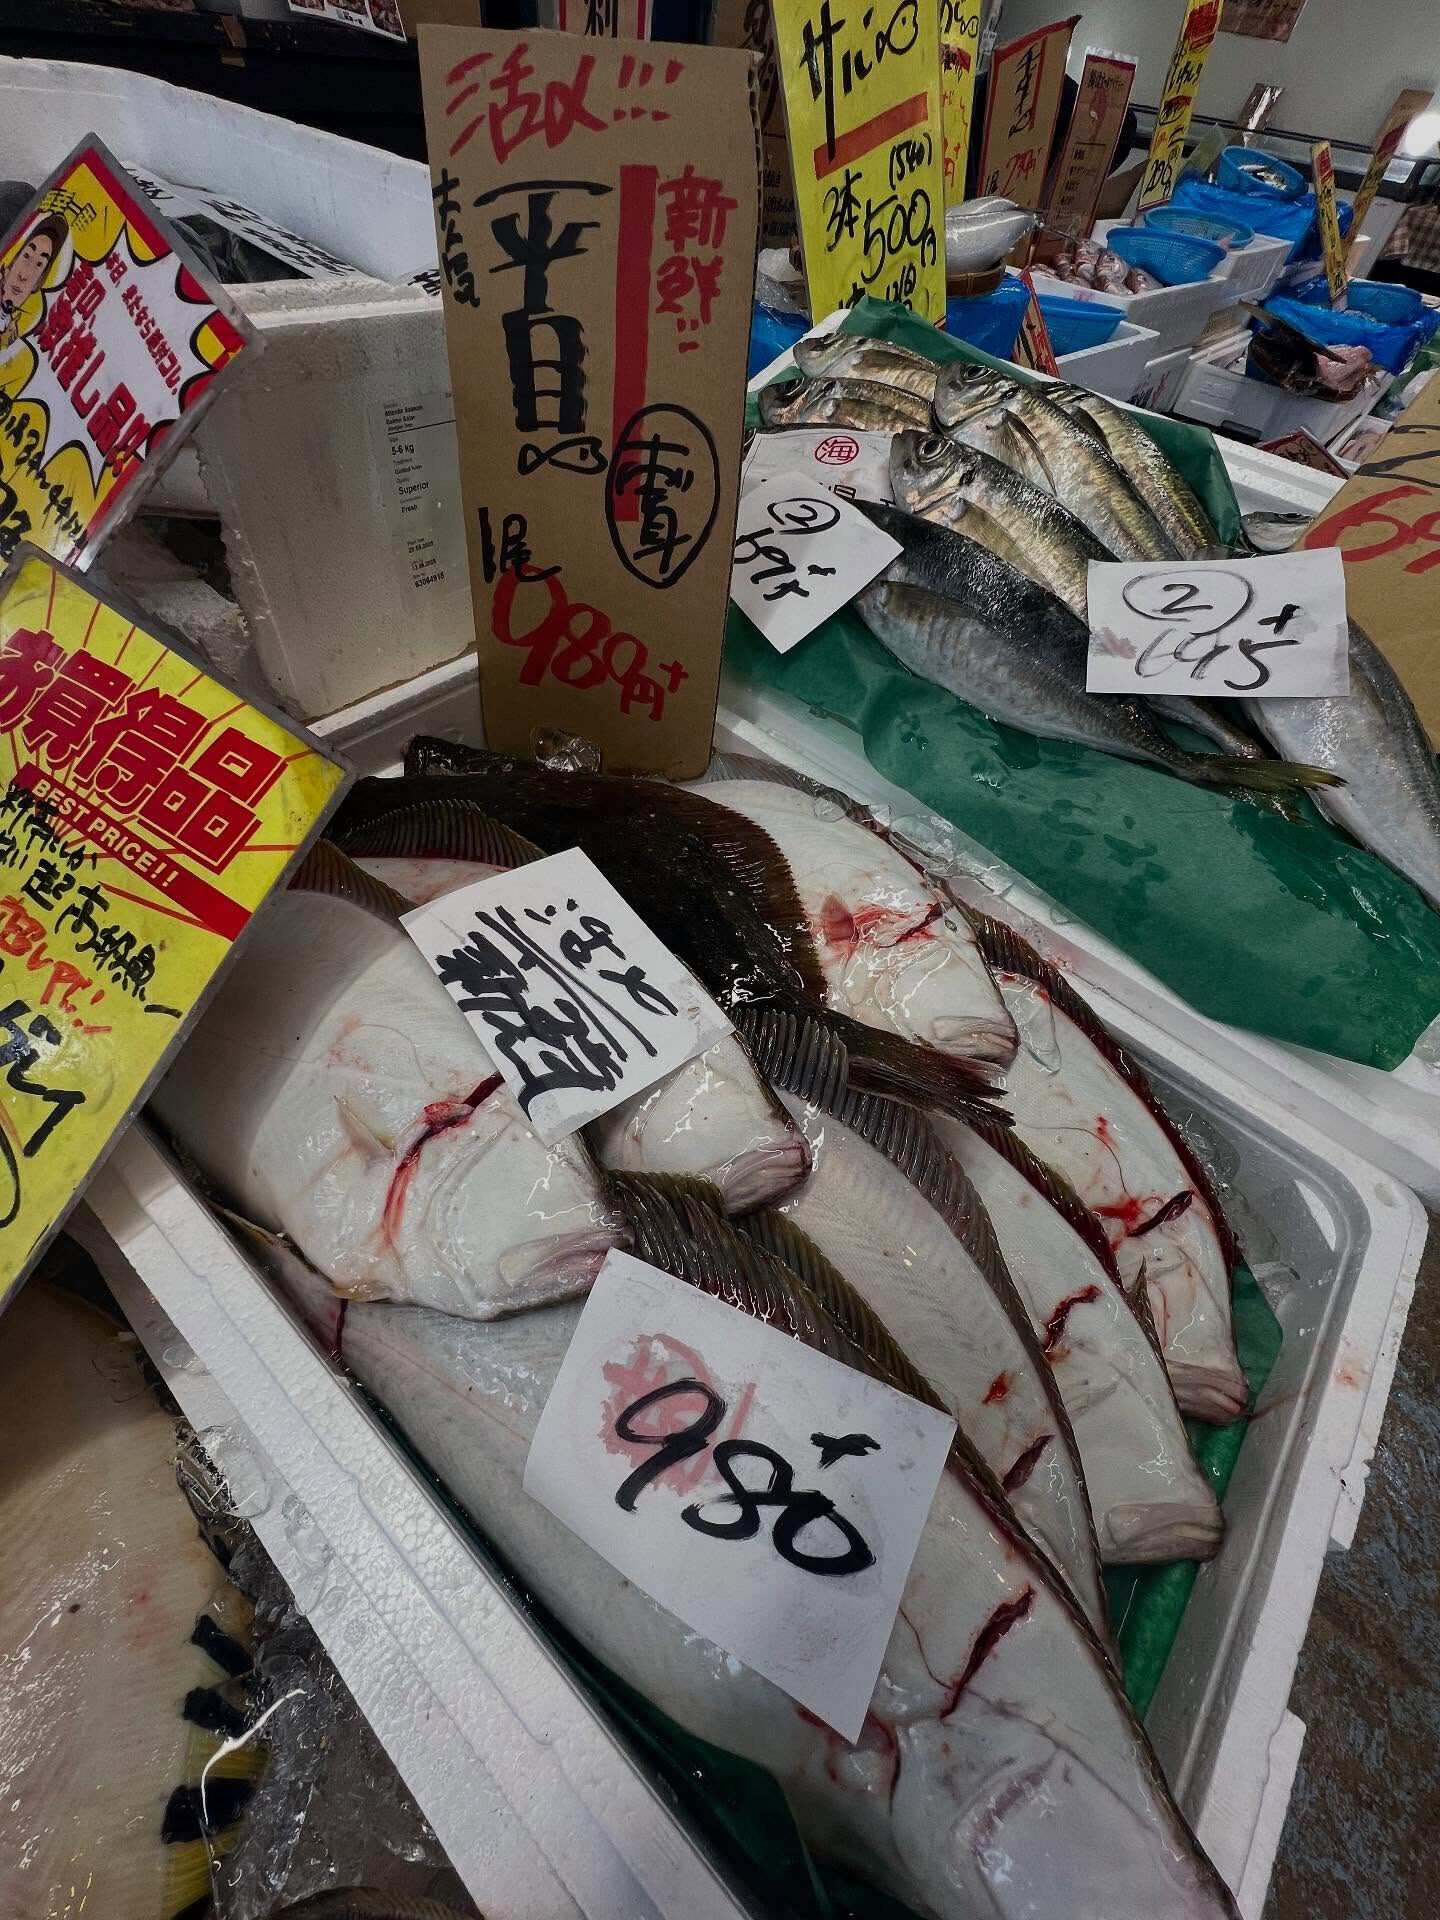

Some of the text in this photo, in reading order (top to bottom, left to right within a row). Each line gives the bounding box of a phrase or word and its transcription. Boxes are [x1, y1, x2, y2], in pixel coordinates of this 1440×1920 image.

[473, 180, 613, 433] 平目
[391, 444, 415, 455] 5-6 kg
[399, 481, 430, 495] Superior
[401, 504, 418, 513] Fresh
[0, 627, 288, 875] お買得品
[32, 779, 180, 887] BEST PRICE!!
[615, 1377, 876, 1576] 980
